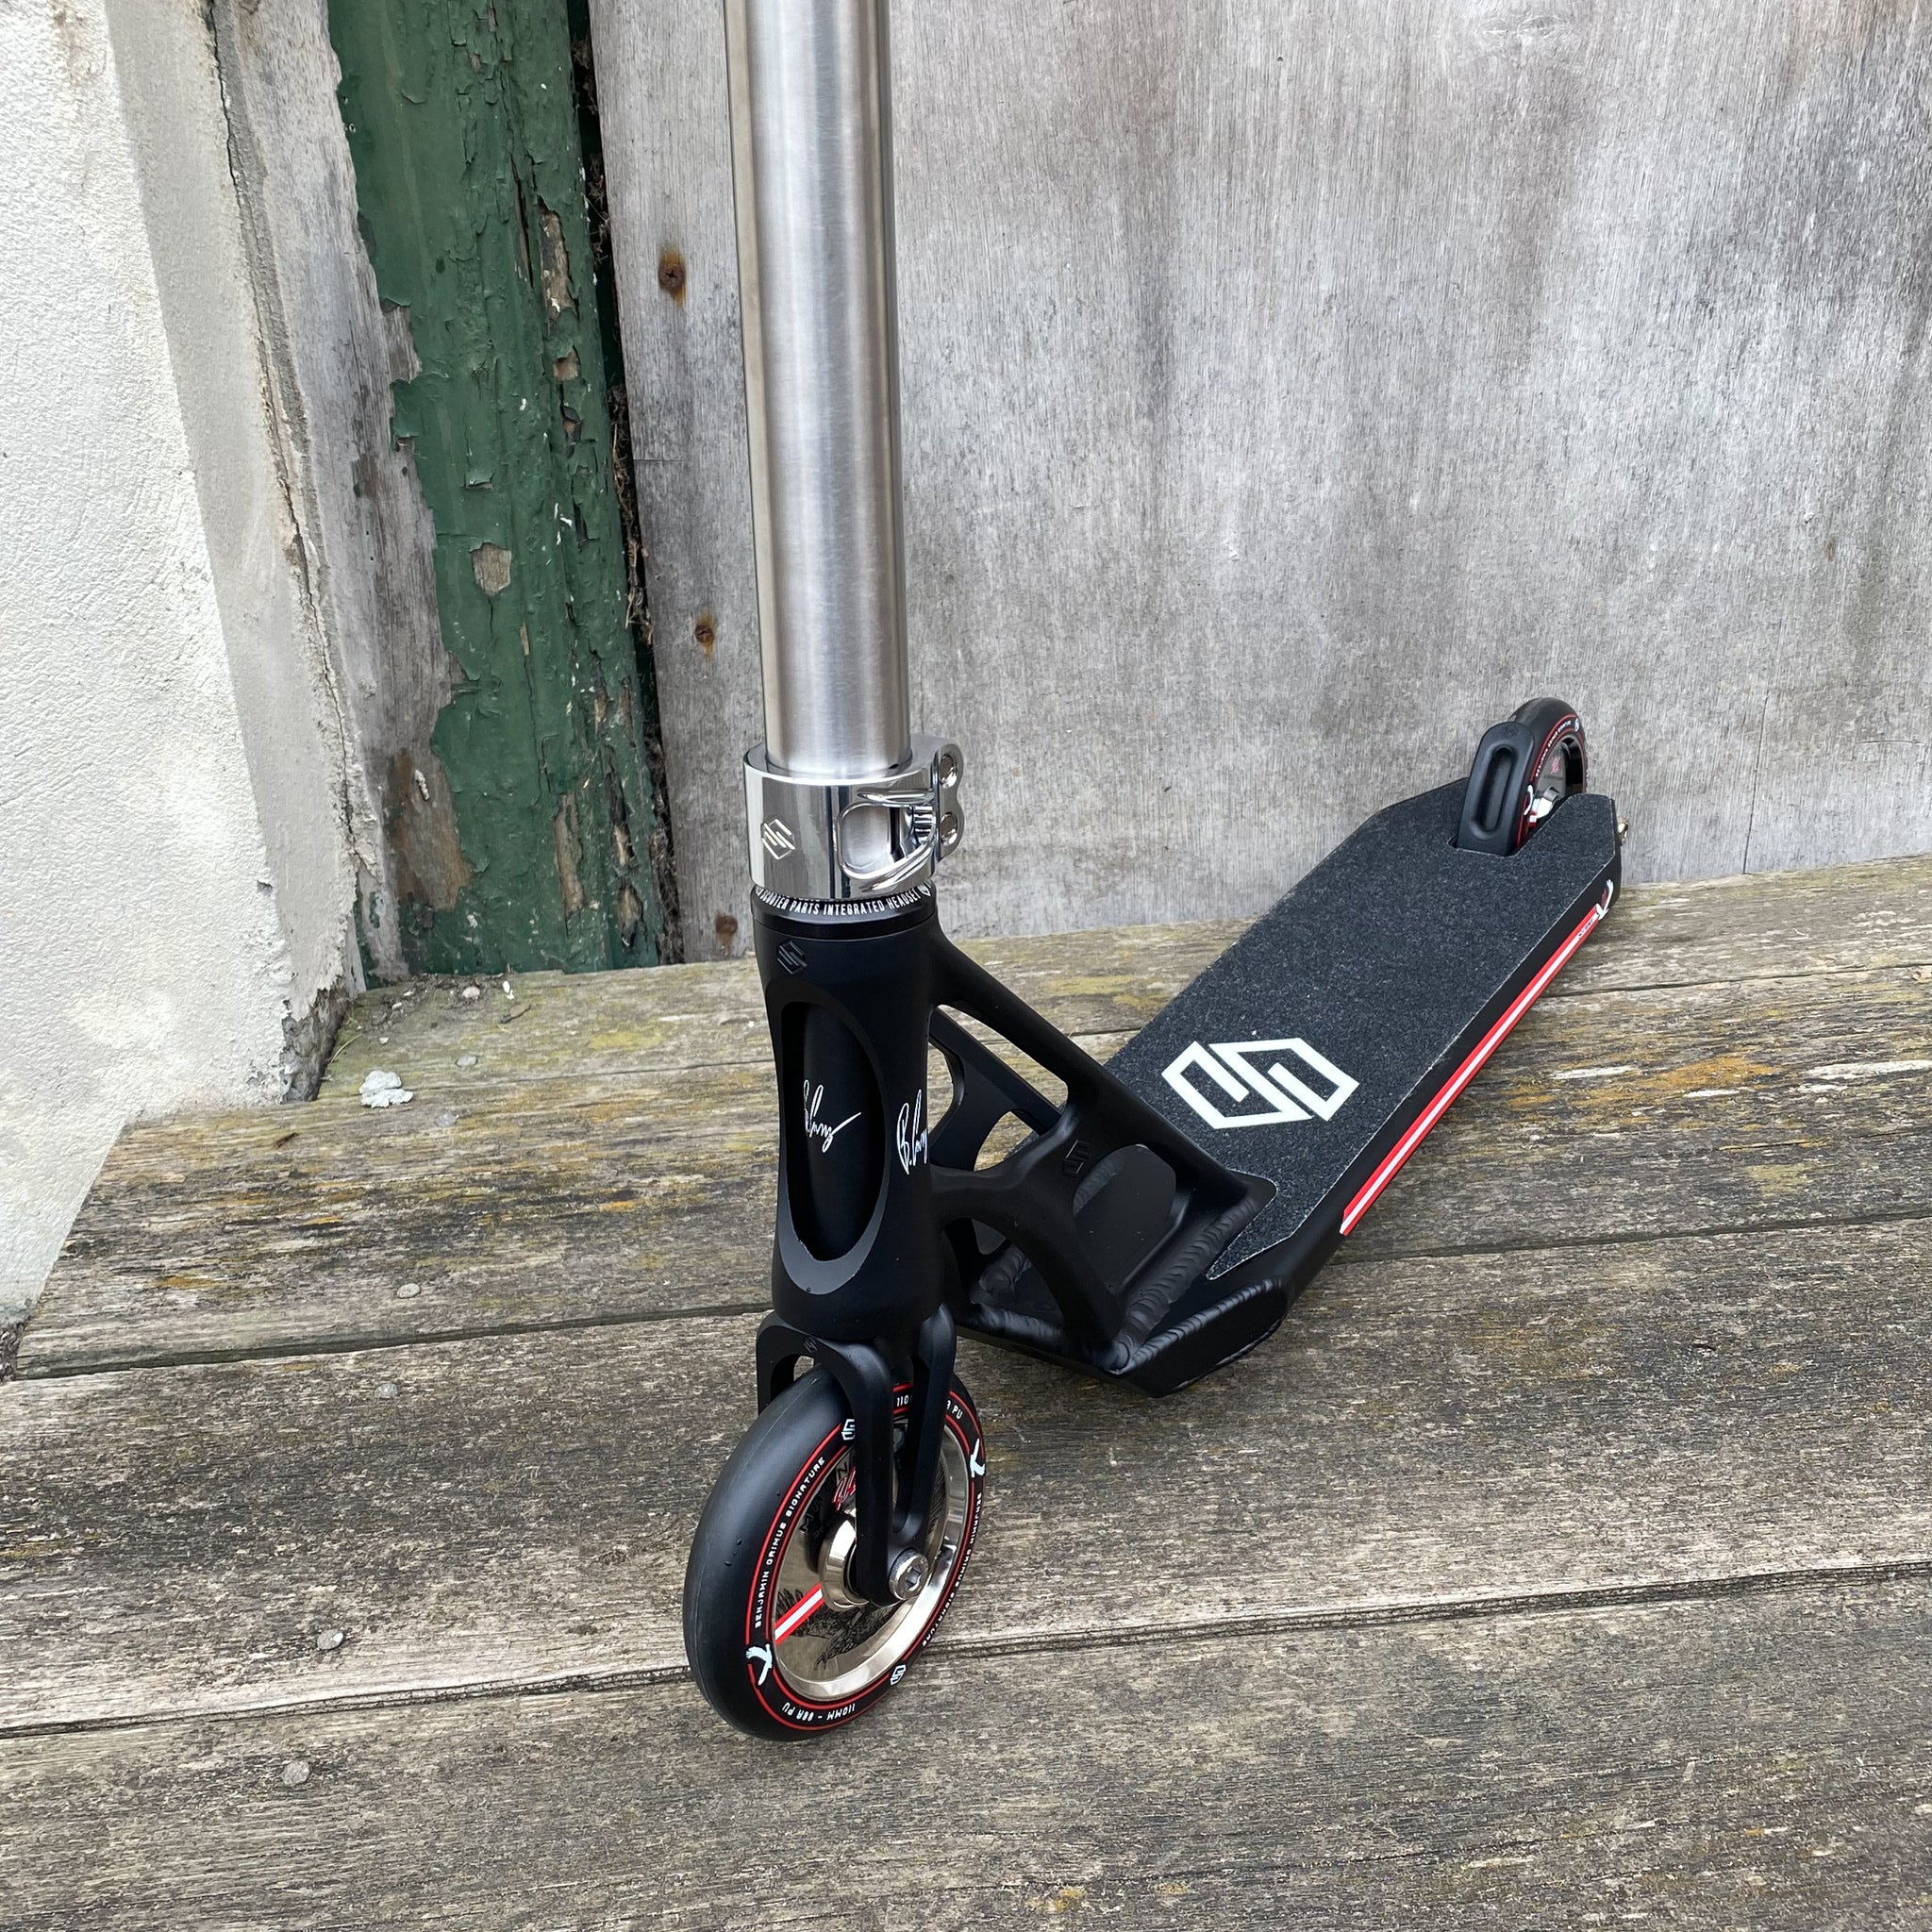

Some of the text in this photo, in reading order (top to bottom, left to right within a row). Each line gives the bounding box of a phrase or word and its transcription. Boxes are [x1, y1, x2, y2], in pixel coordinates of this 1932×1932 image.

[759, 890, 790, 910] SCOOTER
[789, 900, 820, 915] PARTS
[823, 899, 885, 917] INTEGRATED
[885, 888, 922, 909] HEADSET
[896, 1395, 912, 1407] 110
[952, 1405, 963, 1420] PU
[755, 1571, 769, 1628] BENJAMIN
[785, 1457, 825, 1518] SIGNATURE
[781, 1702, 796, 1716] PU
[796, 1708, 814, 1722] 88A
[826, 1703, 856, 1721] 110MM
